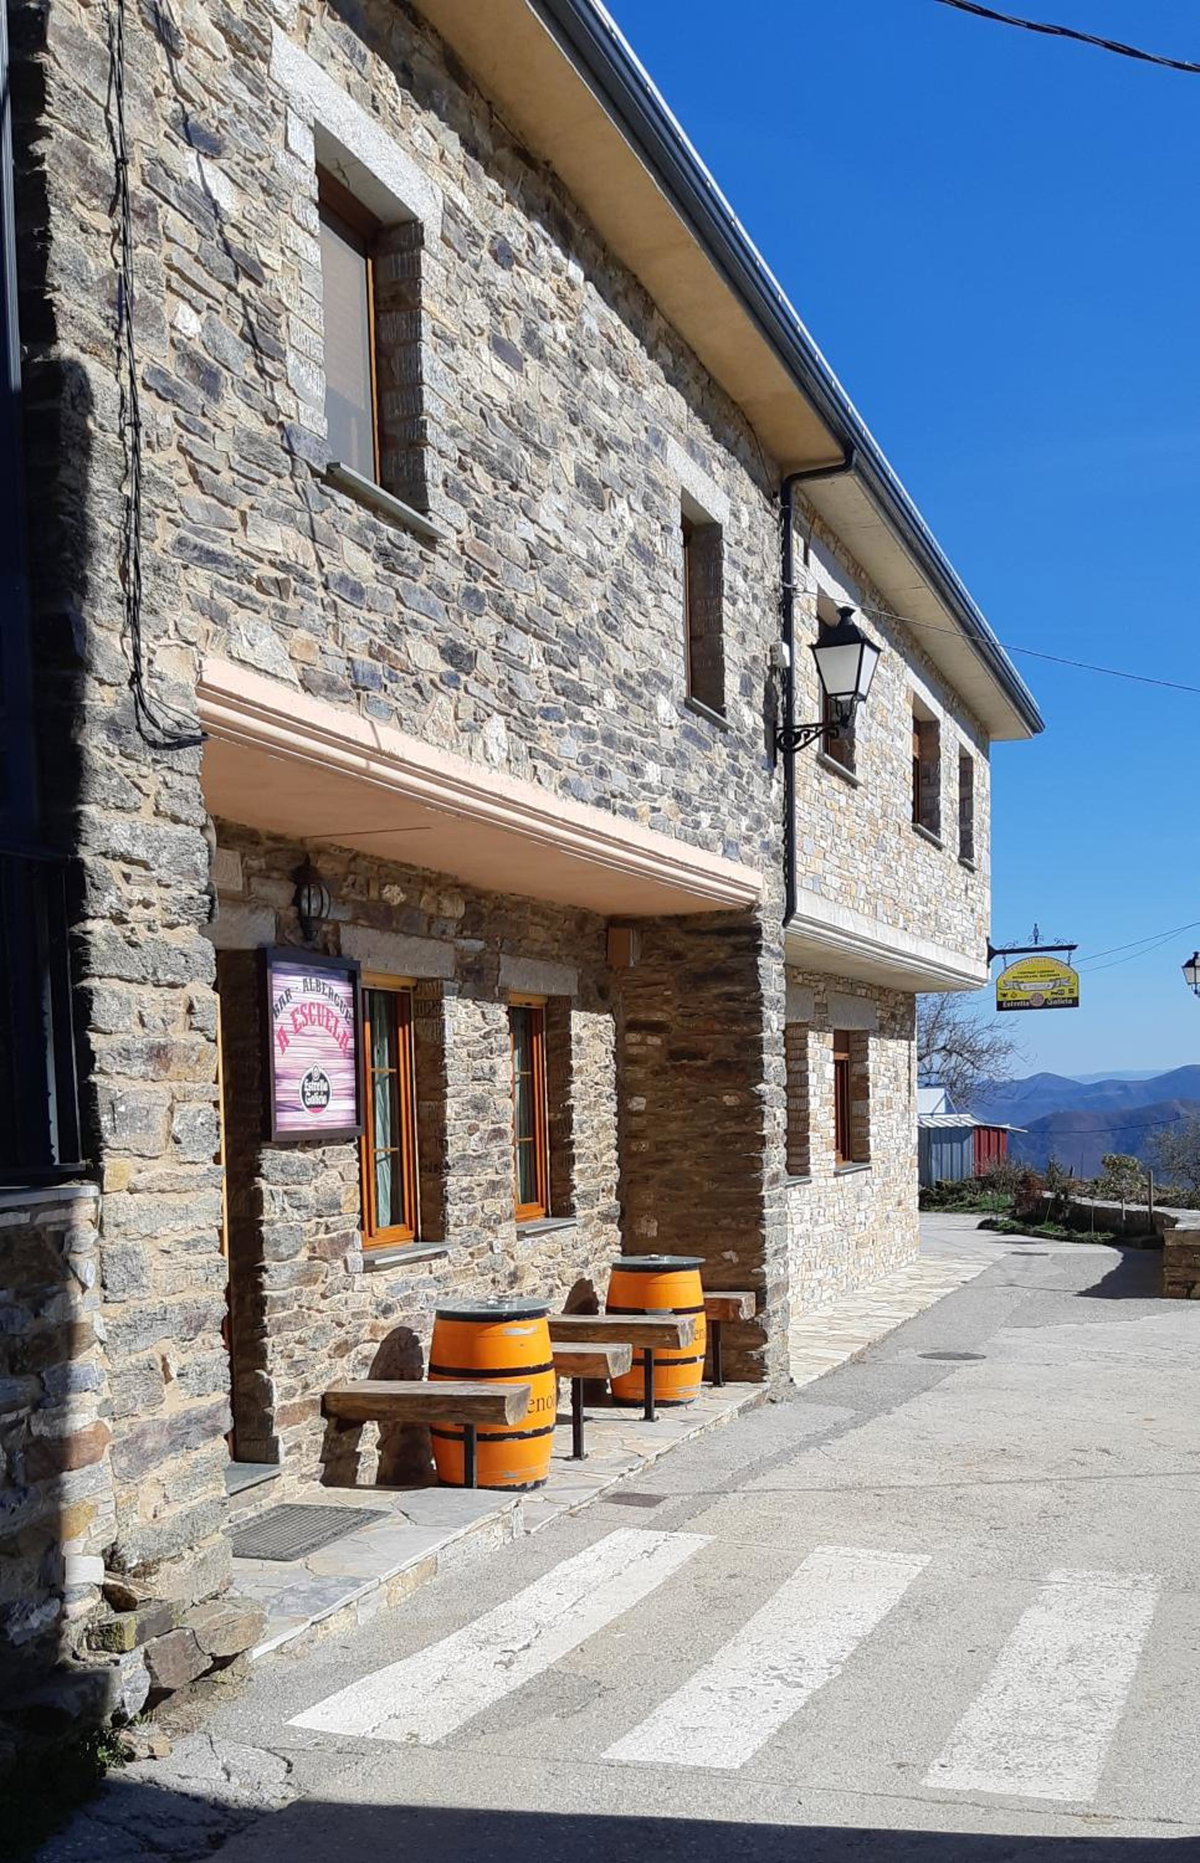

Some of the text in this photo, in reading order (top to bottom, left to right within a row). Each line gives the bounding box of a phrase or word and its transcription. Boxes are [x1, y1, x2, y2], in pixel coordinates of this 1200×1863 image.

[302, 977, 353, 1025] ALBERGUE
[277, 1001, 349, 1056] A ESCUELA
[304, 1078, 328, 1092] Estrella
[305, 1091, 327, 1106] Galicia
